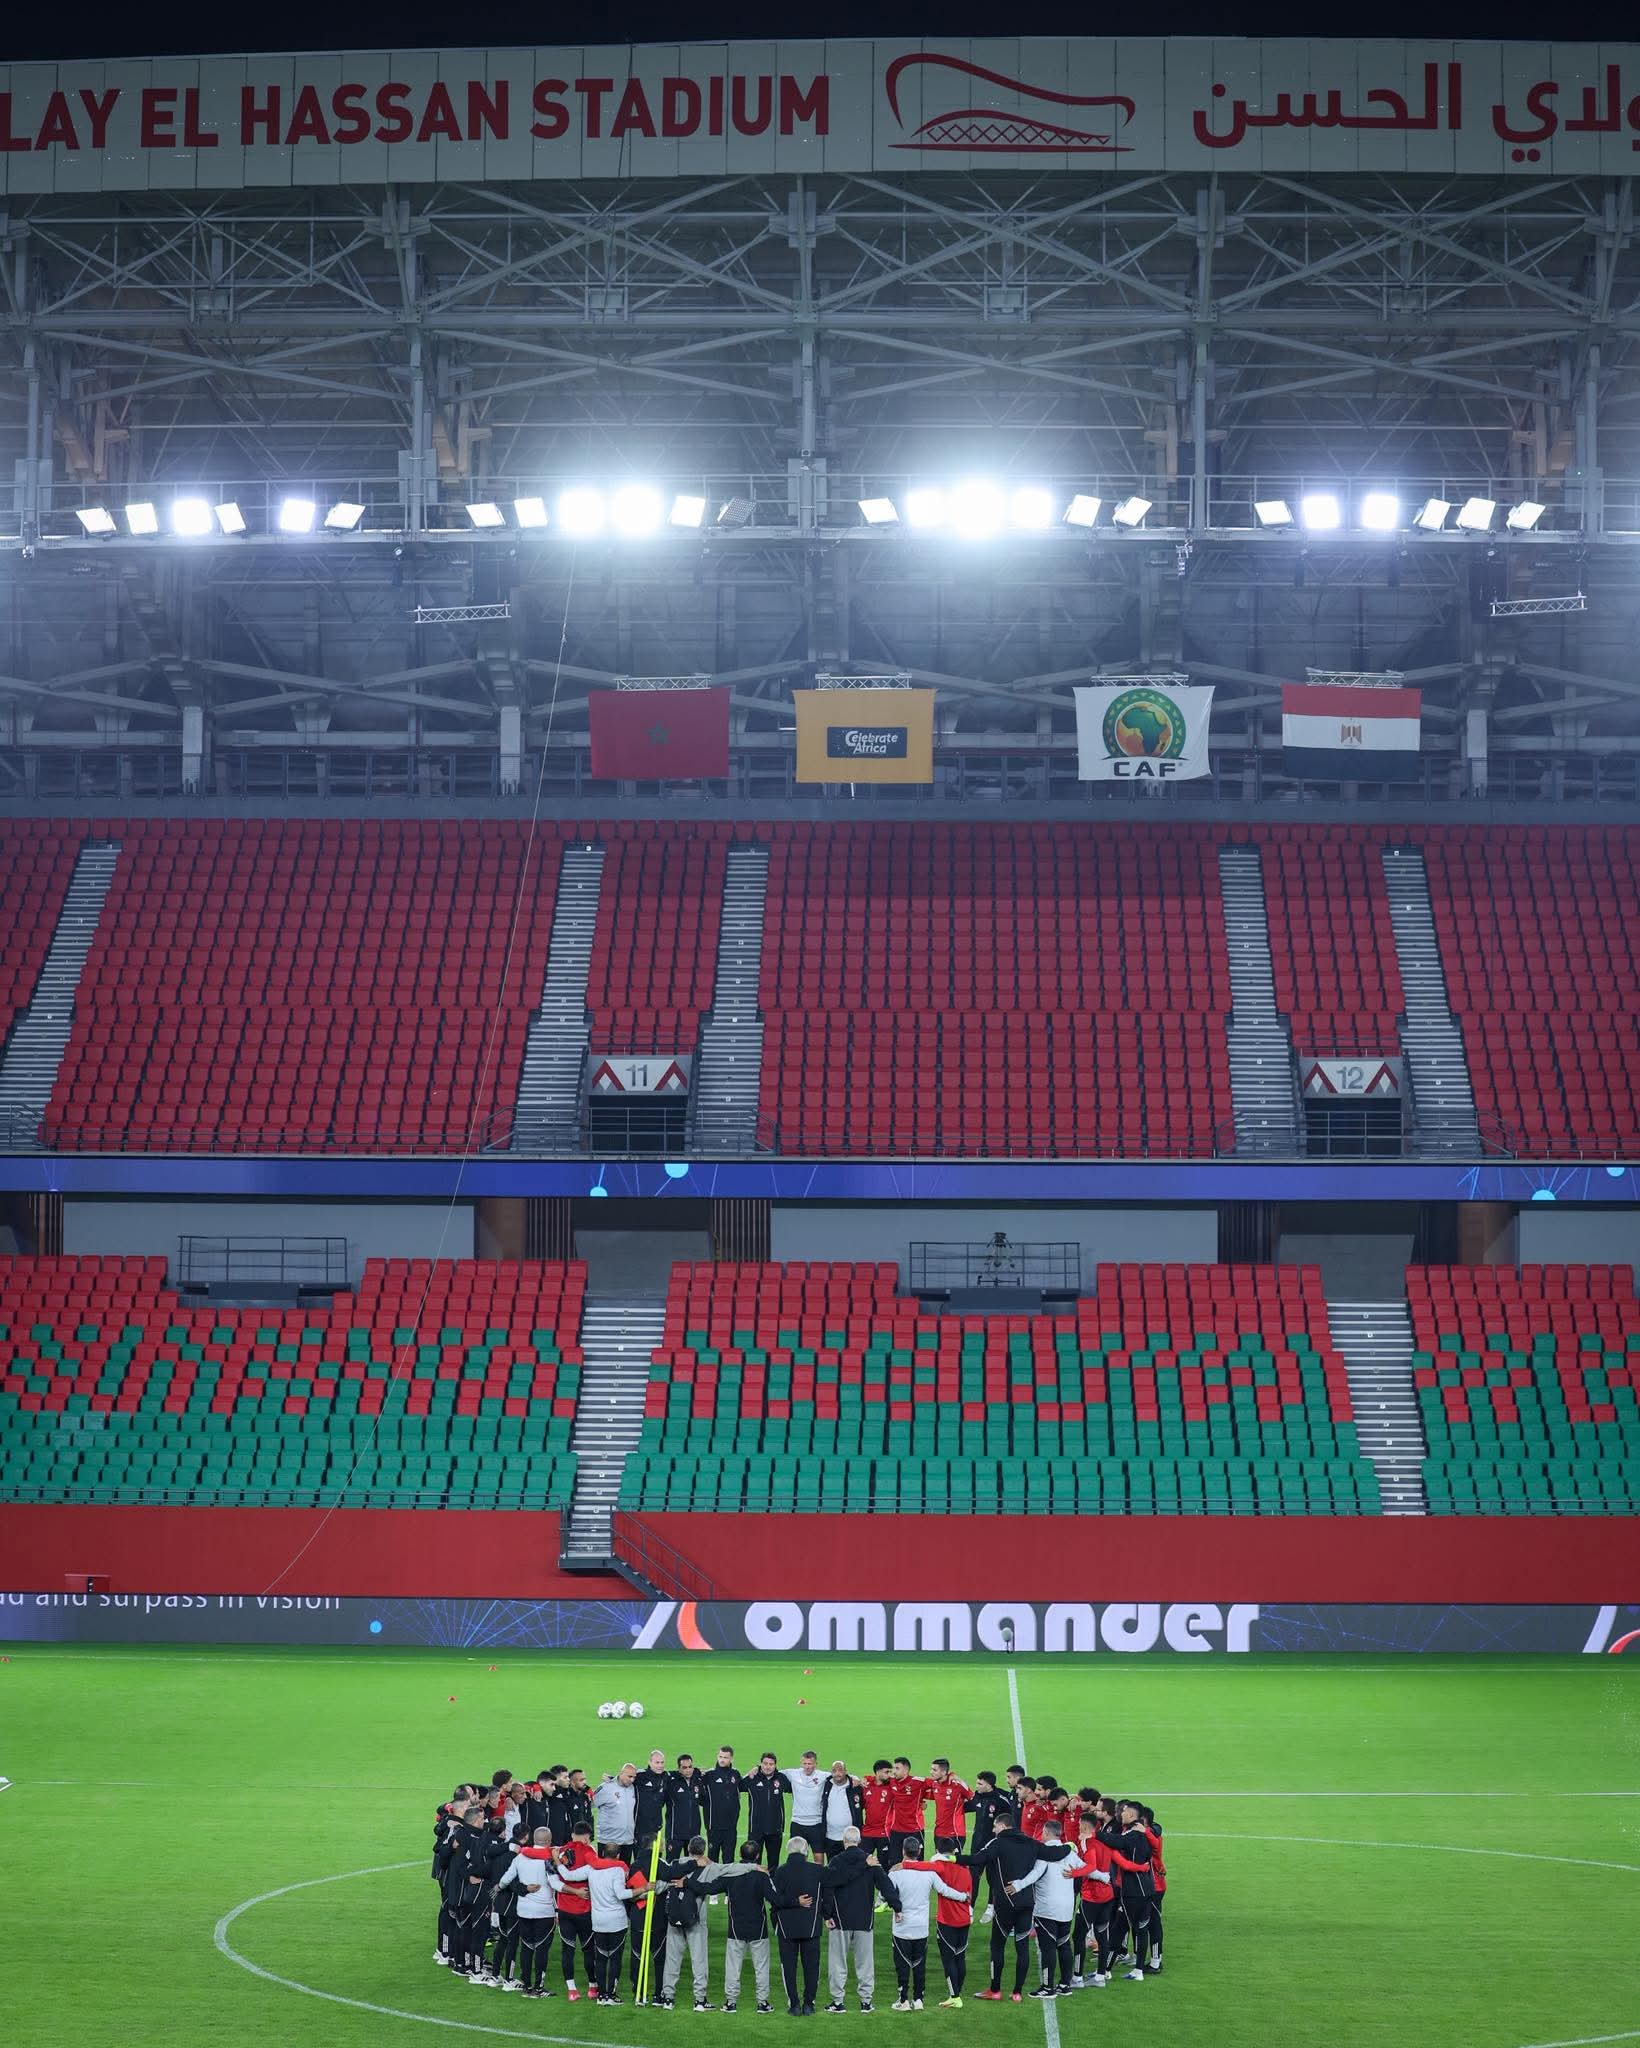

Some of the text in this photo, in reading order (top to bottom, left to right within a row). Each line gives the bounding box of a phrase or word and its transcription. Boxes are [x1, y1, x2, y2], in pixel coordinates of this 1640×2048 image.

[0, 76, 829, 151] LAY EL HASSAN STADIUM
[1193, 63, 1462, 147] الحسن
[845, 730, 898, 746] Celebrate
[853, 742, 887, 754] Africa
[1113, 761, 1176, 777] CAF
[626, 1064, 648, 1087] 11
[1337, 1066, 1365, 1089] 12
